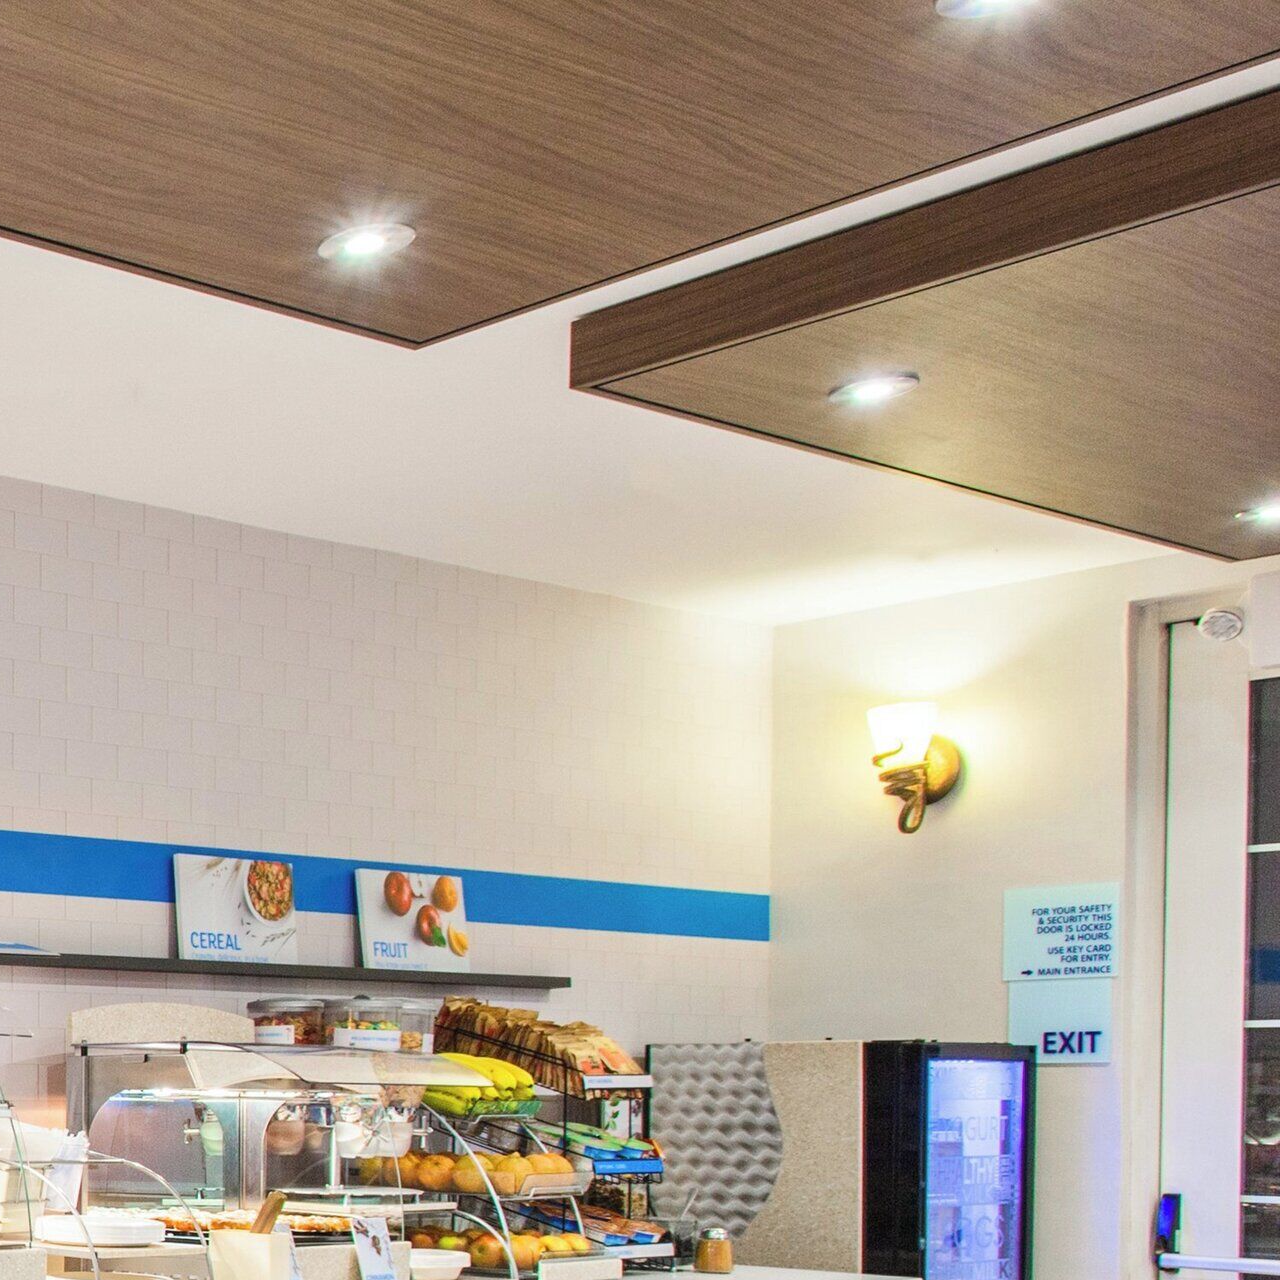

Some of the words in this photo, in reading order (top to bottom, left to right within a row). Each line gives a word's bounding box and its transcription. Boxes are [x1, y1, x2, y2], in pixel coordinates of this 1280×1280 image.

[1032, 907, 1049, 916] FOR
[1052, 905, 1076, 915] YOUR
[1079, 903, 1112, 913] SAFETY
[1038, 917, 1044, 925] &
[1047, 915, 1089, 925] SECURITY
[1092, 913, 1112, 922] THIS
[1037, 925, 1063, 935] DOOR
[1066, 924, 1074, 933] IS
[1076, 923, 1112, 932] LOCKED
[190, 931, 242, 951] CEREAL
[1065, 934, 1075, 942] 24
[1078, 932, 1112, 941] HOURS.
[373, 941, 408, 958] FRUIT
[1047, 946, 1064, 955] USE
[1066, 945, 1083, 954] KEY
[1086, 943, 1112, 953] CARD
[1060, 955, 1079, 963] FOR
[1081, 953, 1112, 962] ENTRY.
[1037, 967, 1061, 976] MAIN
[1064, 965, 1112, 975] ENTRANCE
[1043, 1030, 1102, 1054] EXIT
